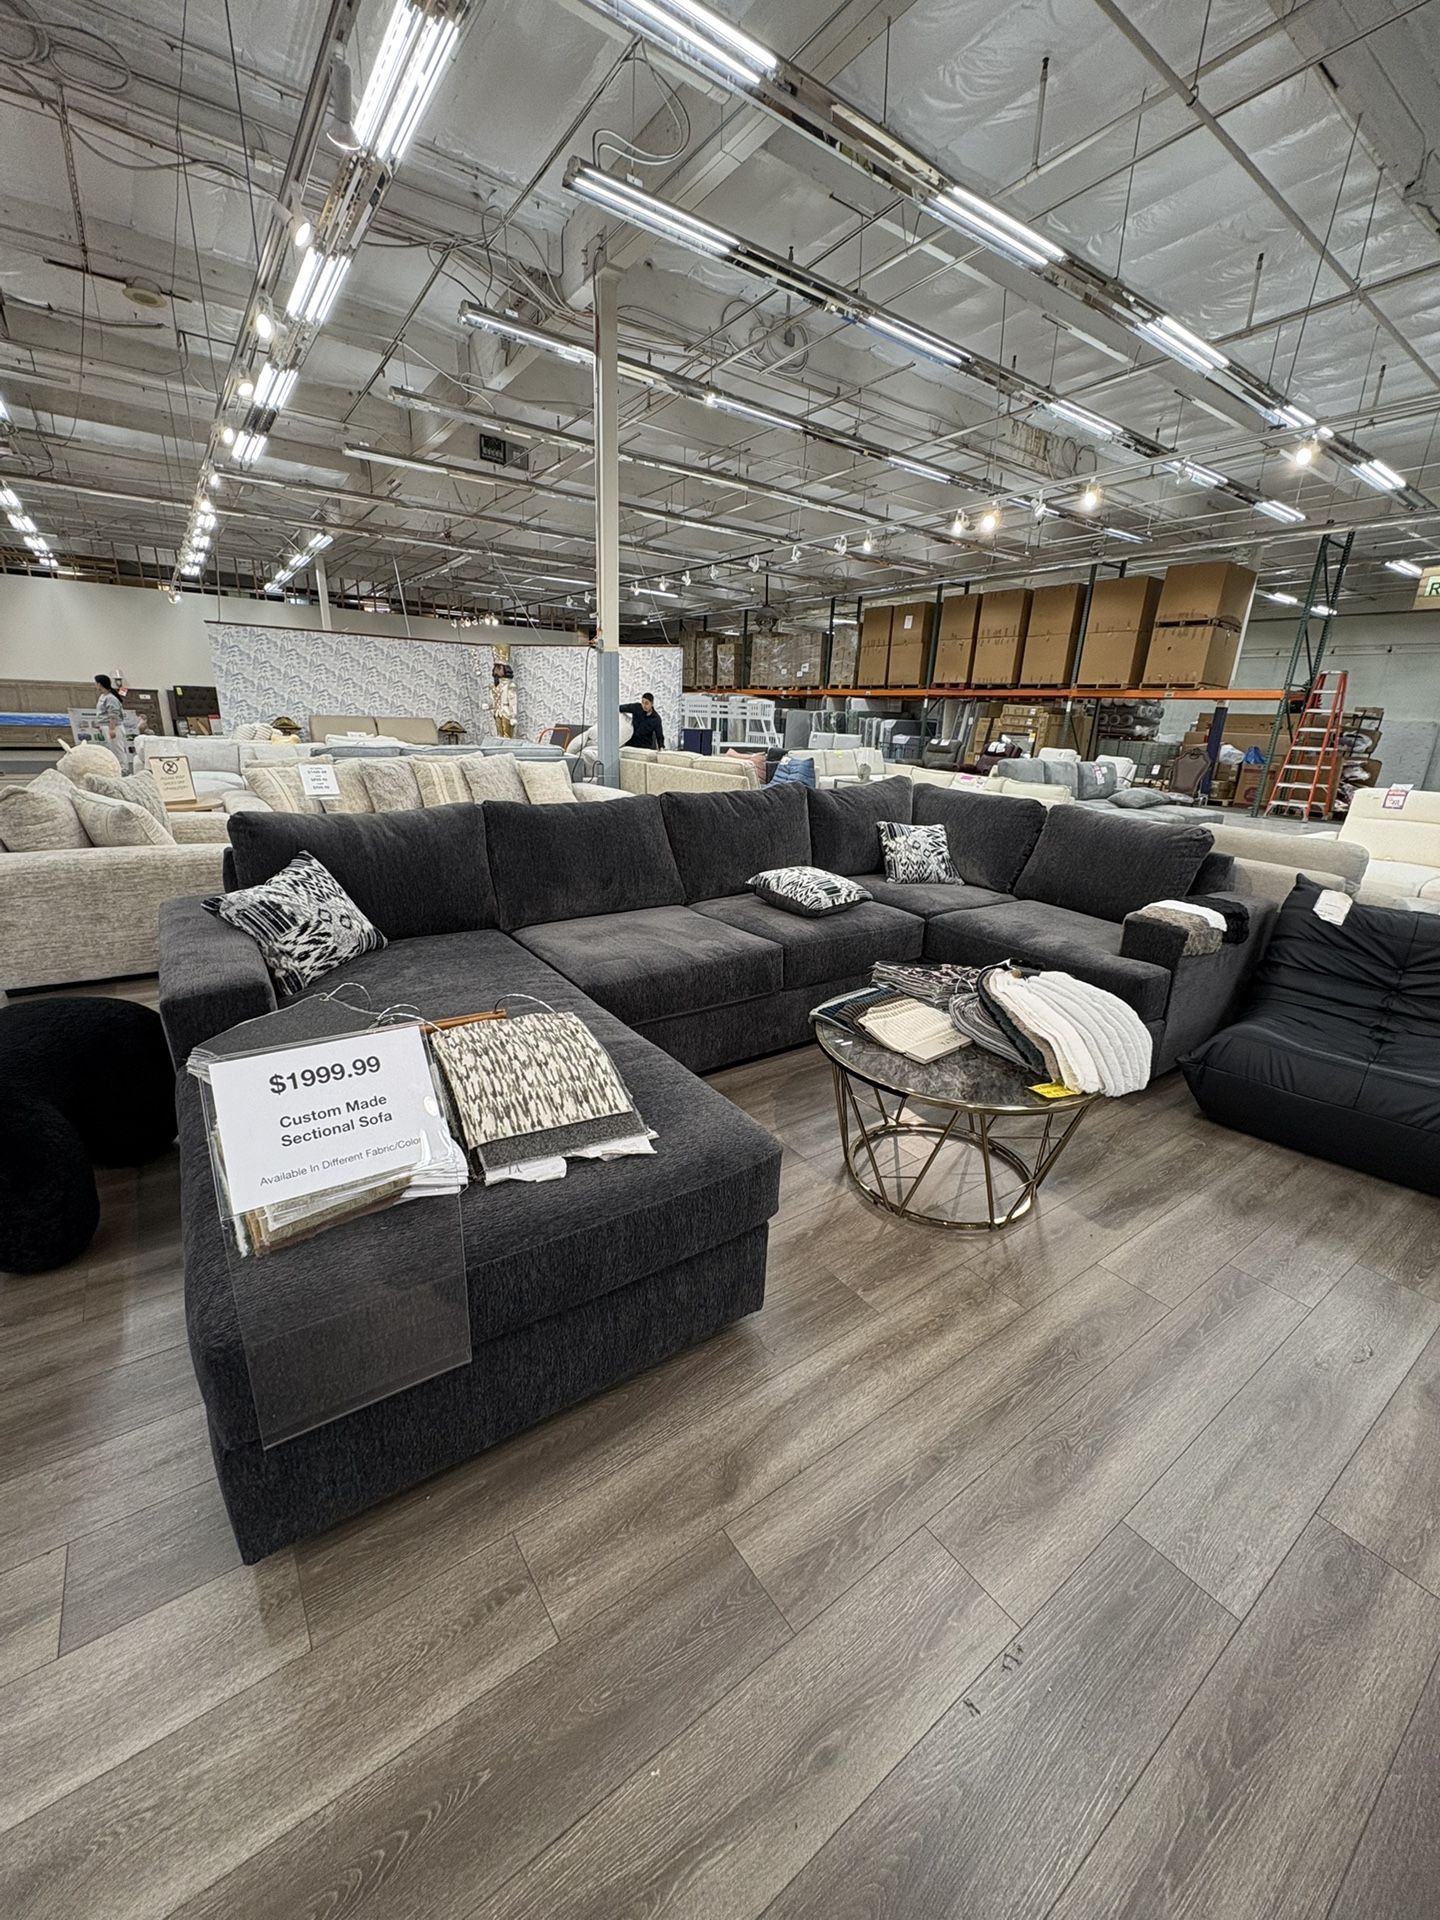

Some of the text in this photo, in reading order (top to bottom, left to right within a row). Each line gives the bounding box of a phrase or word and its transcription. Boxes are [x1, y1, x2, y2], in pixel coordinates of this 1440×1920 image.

[269, 1055, 381, 1095] $1999.99
[280, 1095, 387, 1128] Custom Made
[281, 1111, 393, 1147] Sectional Sofa
[259, 1167, 308, 1187] Available
[310, 1164, 320, 1174] In
[322, 1151, 364, 1170] Different
